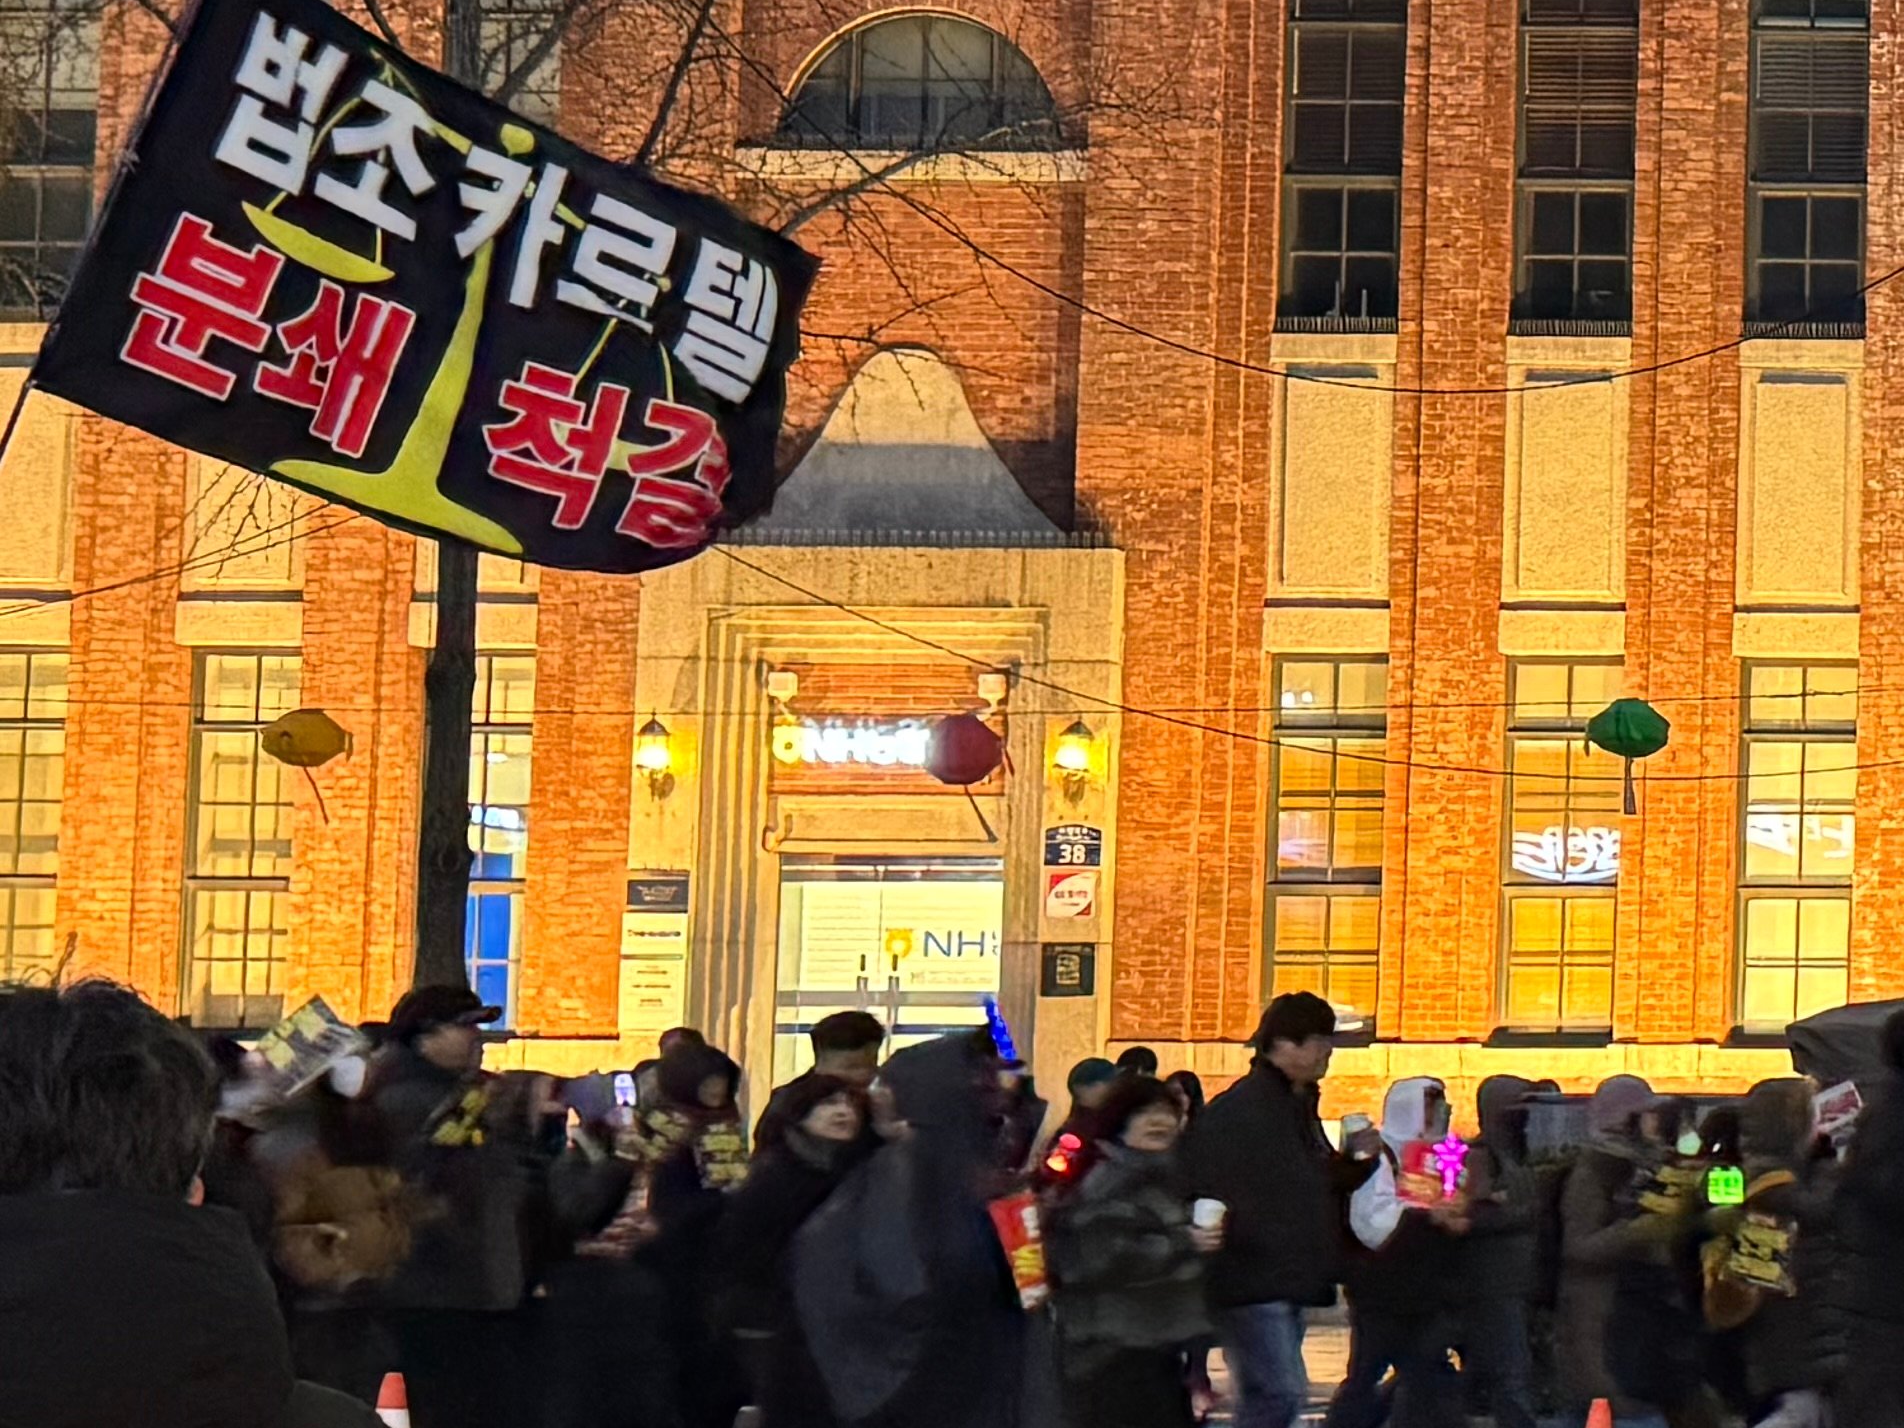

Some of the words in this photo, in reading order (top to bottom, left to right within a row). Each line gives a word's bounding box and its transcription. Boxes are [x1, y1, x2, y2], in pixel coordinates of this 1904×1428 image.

[214, 10, 778, 404] 법조카르텔
[119, 211, 415, 458] 분쇄
[482, 360, 733, 549] 척결
[1058, 843, 1087, 865] 38
